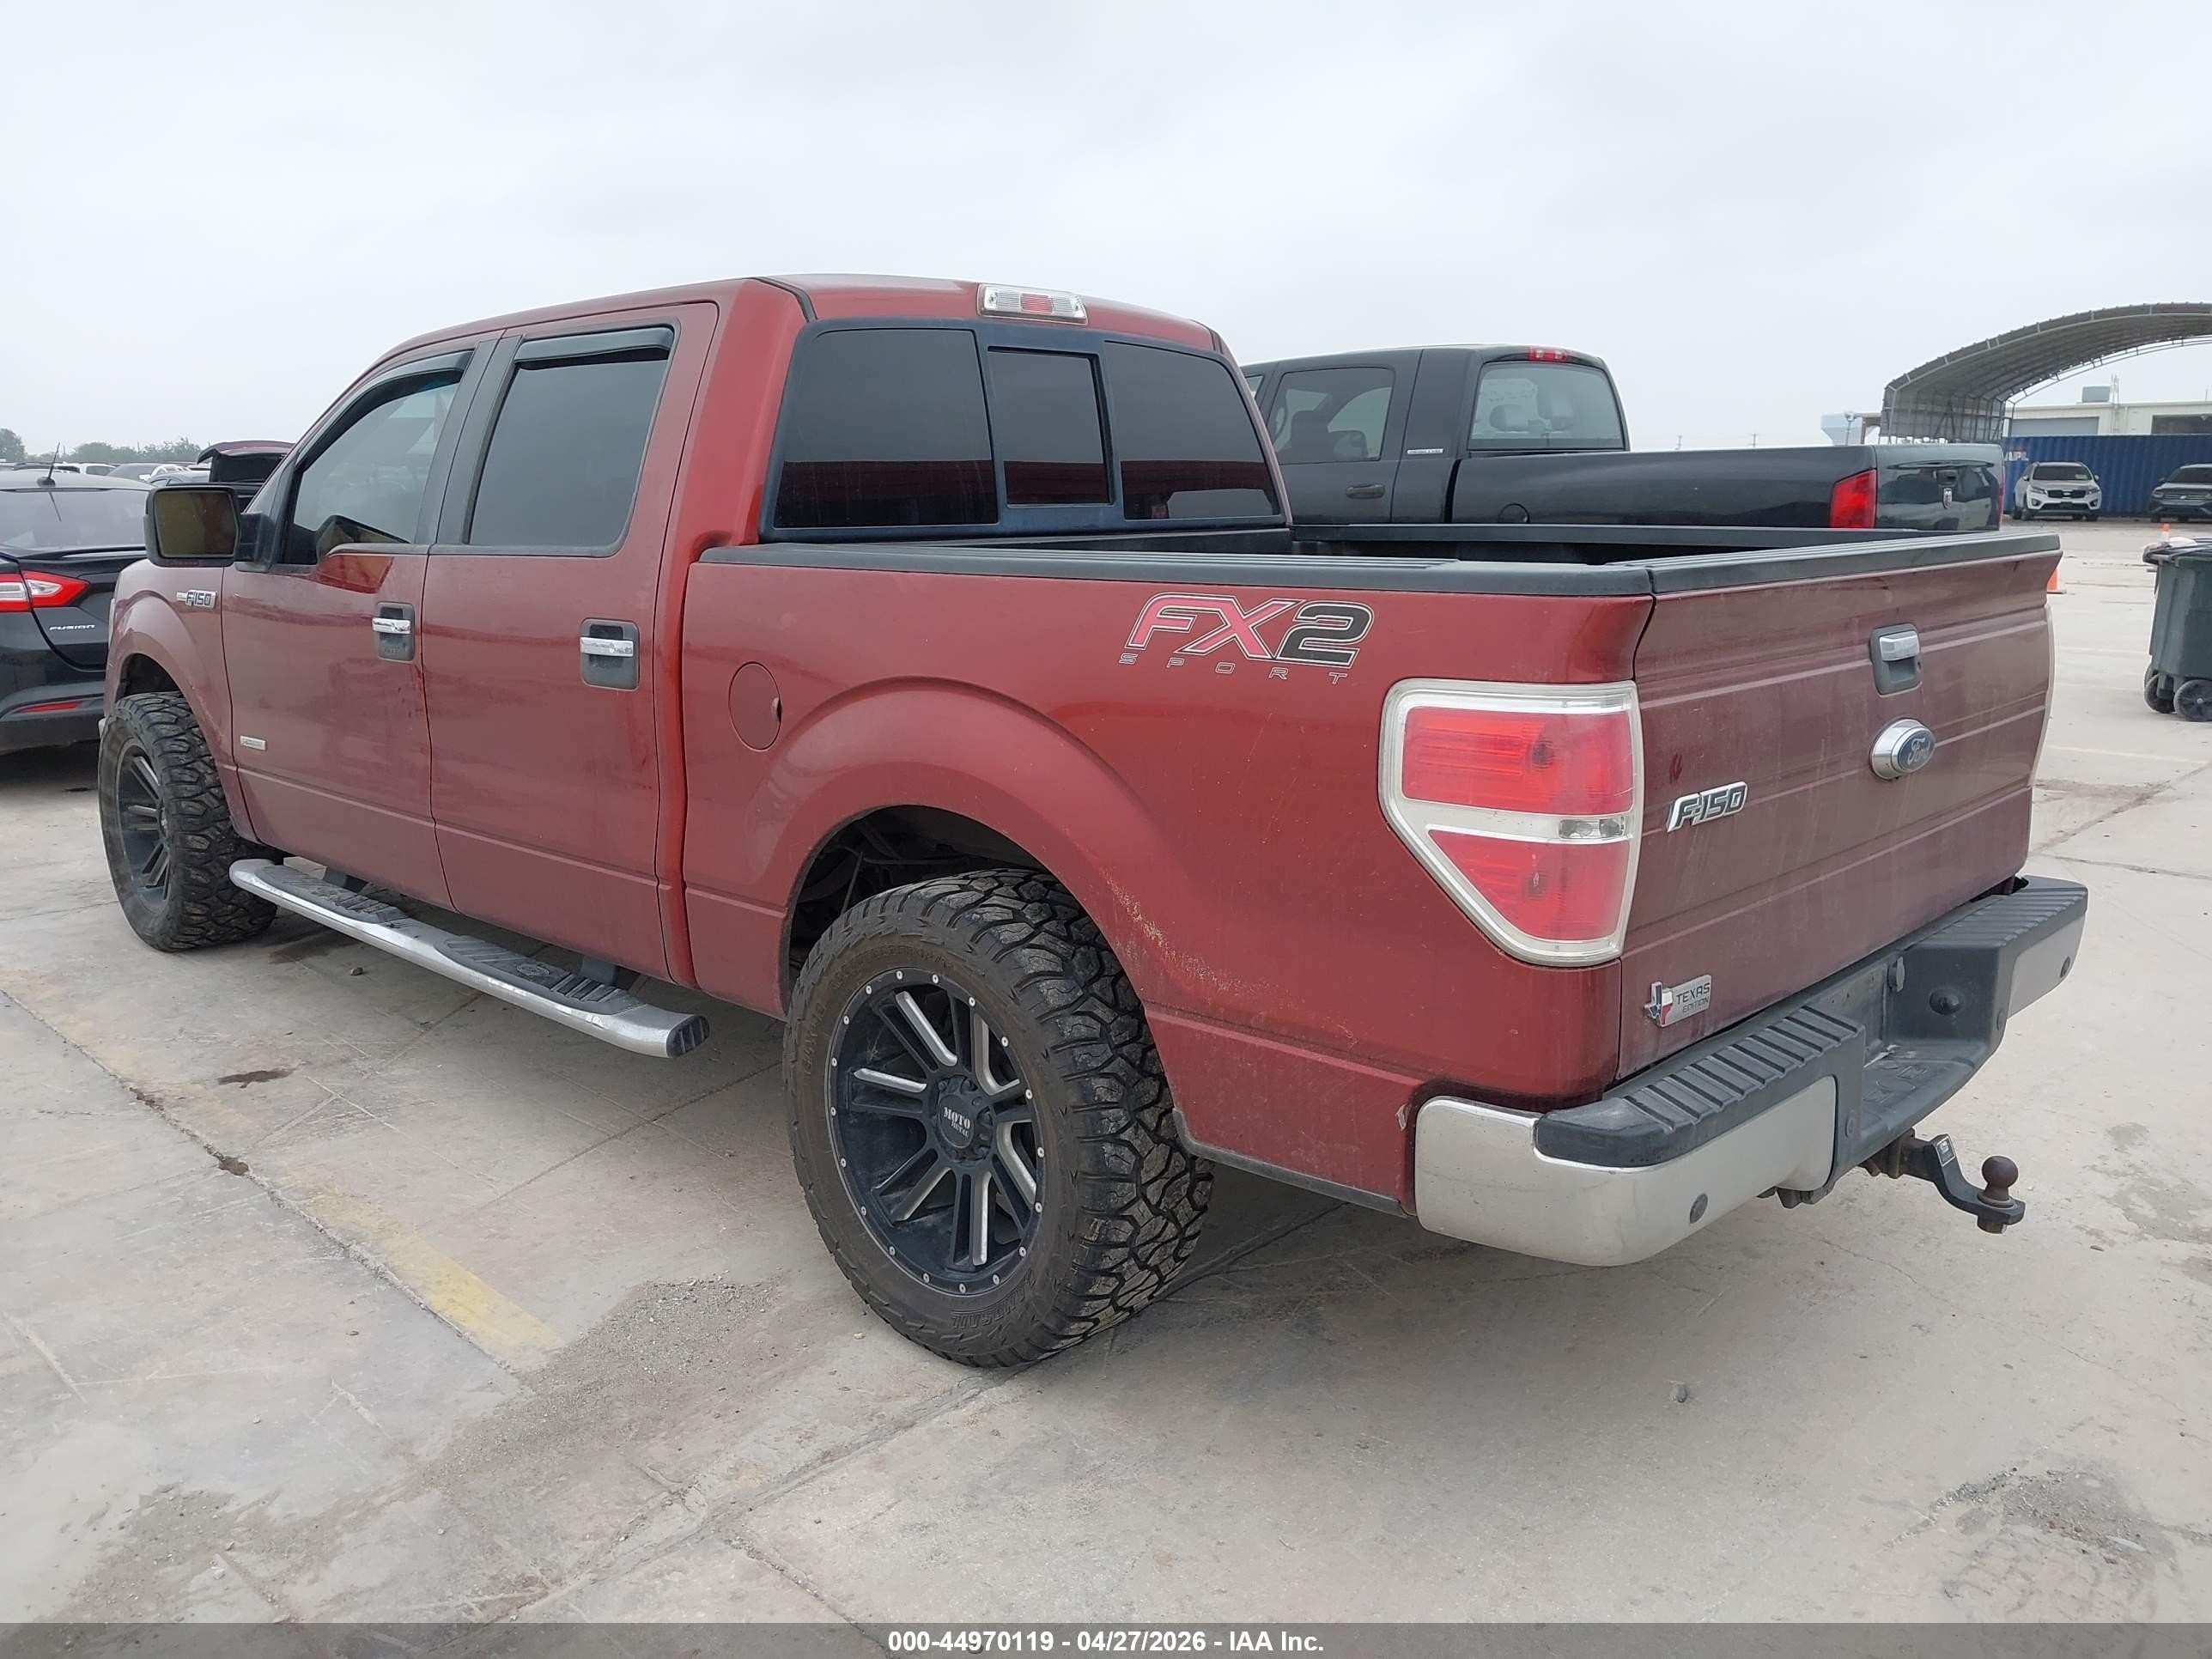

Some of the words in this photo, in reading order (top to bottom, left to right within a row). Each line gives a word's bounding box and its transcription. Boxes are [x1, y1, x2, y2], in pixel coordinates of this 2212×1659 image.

[1125, 592, 1375, 668] FX2
[1118, 653, 1347, 685] SPORT
[1669, 782, 1747, 831] F-150
[1676, 982, 1711, 1006] TEXAS
[1683, 996, 1710, 1013] EDITION
[944, 1106, 971, 1130] MOTO
